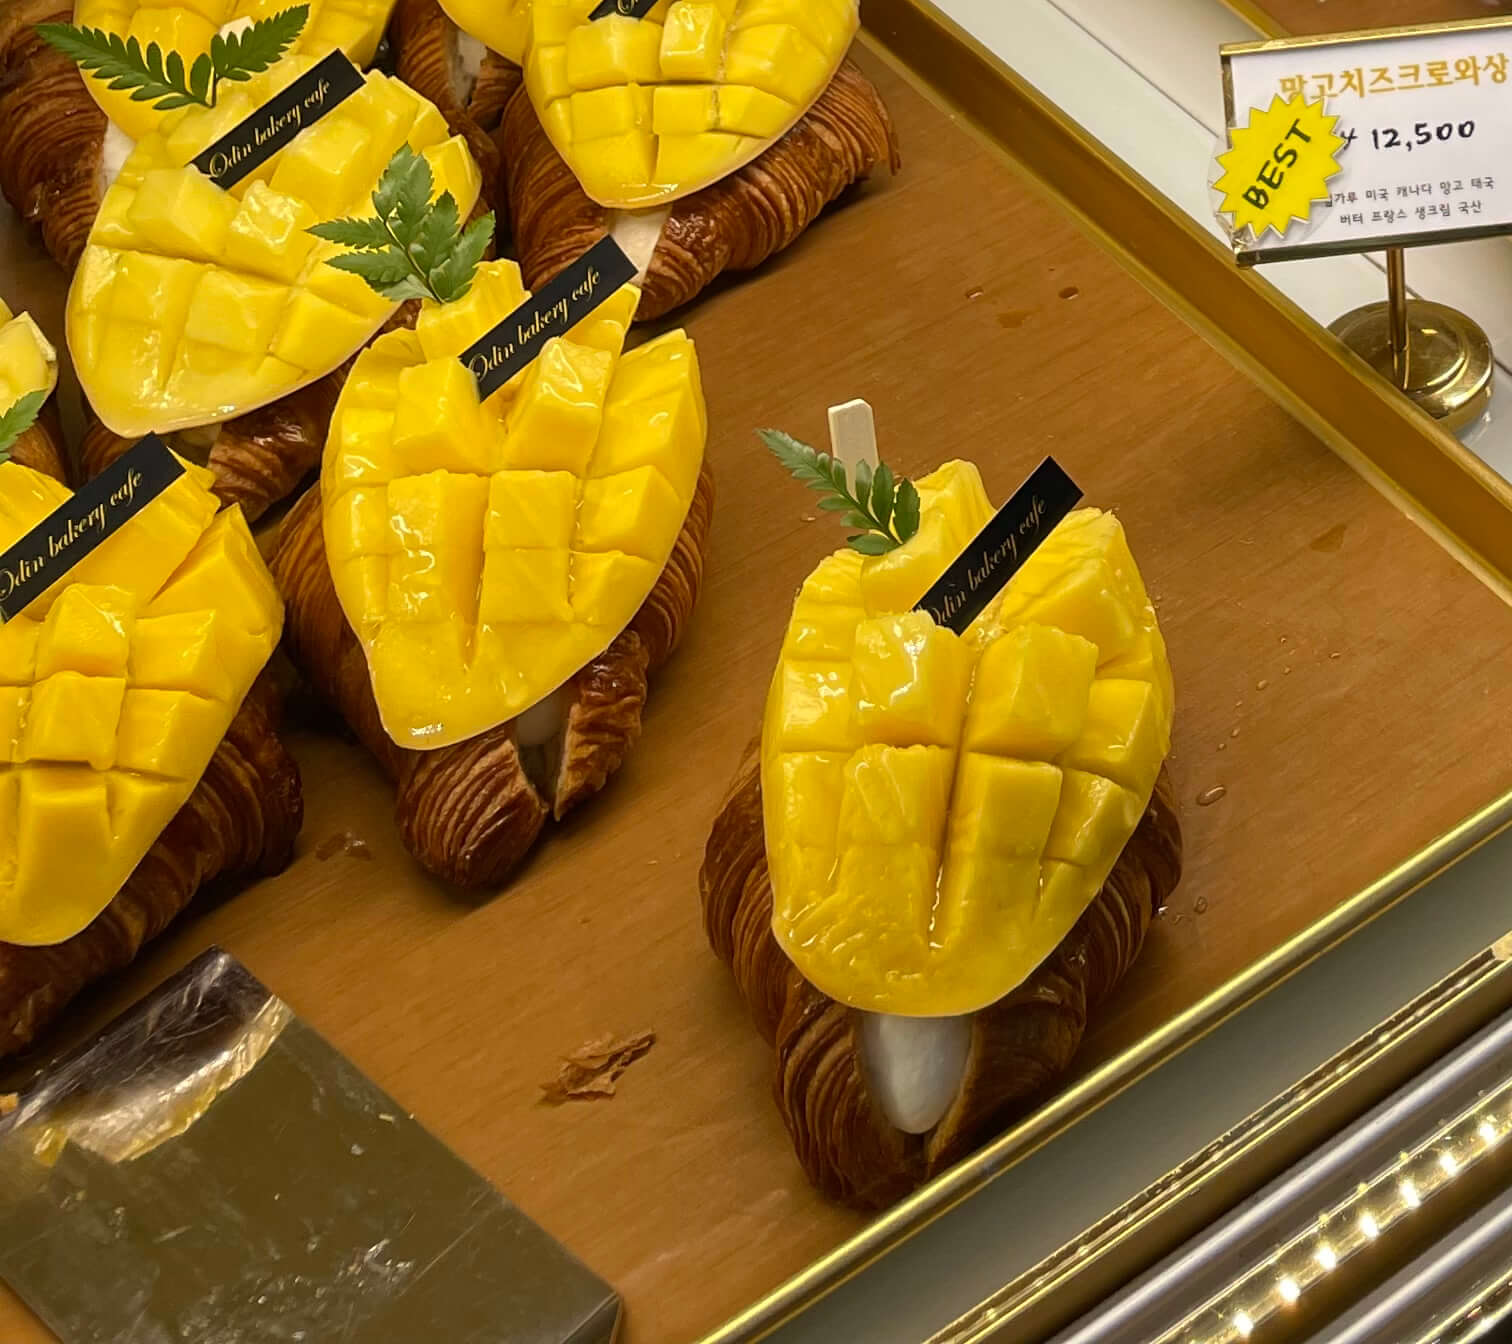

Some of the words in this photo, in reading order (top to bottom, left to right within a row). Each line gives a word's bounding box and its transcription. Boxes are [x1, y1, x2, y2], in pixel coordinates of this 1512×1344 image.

[1279, 52, 1510, 102] 망고치즈크로와상
[209, 142, 253, 179] Odin
[254, 104, 303, 147] bakery
[303, 77, 331, 108] cafe
[1241, 118, 1312, 210] BEST
[1371, 120, 1475, 152] 12,500
[1340, 213, 1364, 225] 버터
[1371, 208, 1408, 224] 프랑스
[1415, 203, 1451, 220] 생크림
[1457, 200, 1482, 214] 국산
[1365, 188, 1389, 202] 미국
[1439, 180, 1464, 195] 망고
[469, 342, 516, 383] Odin
[517, 297, 569, 346] bakery
[571, 265, 601, 303] cafe
[48, 503, 107, 559] bakery
[109, 467, 144, 508] cafe
[967, 532, 1019, 592] bakery
[1018, 494, 1047, 535] cafe
